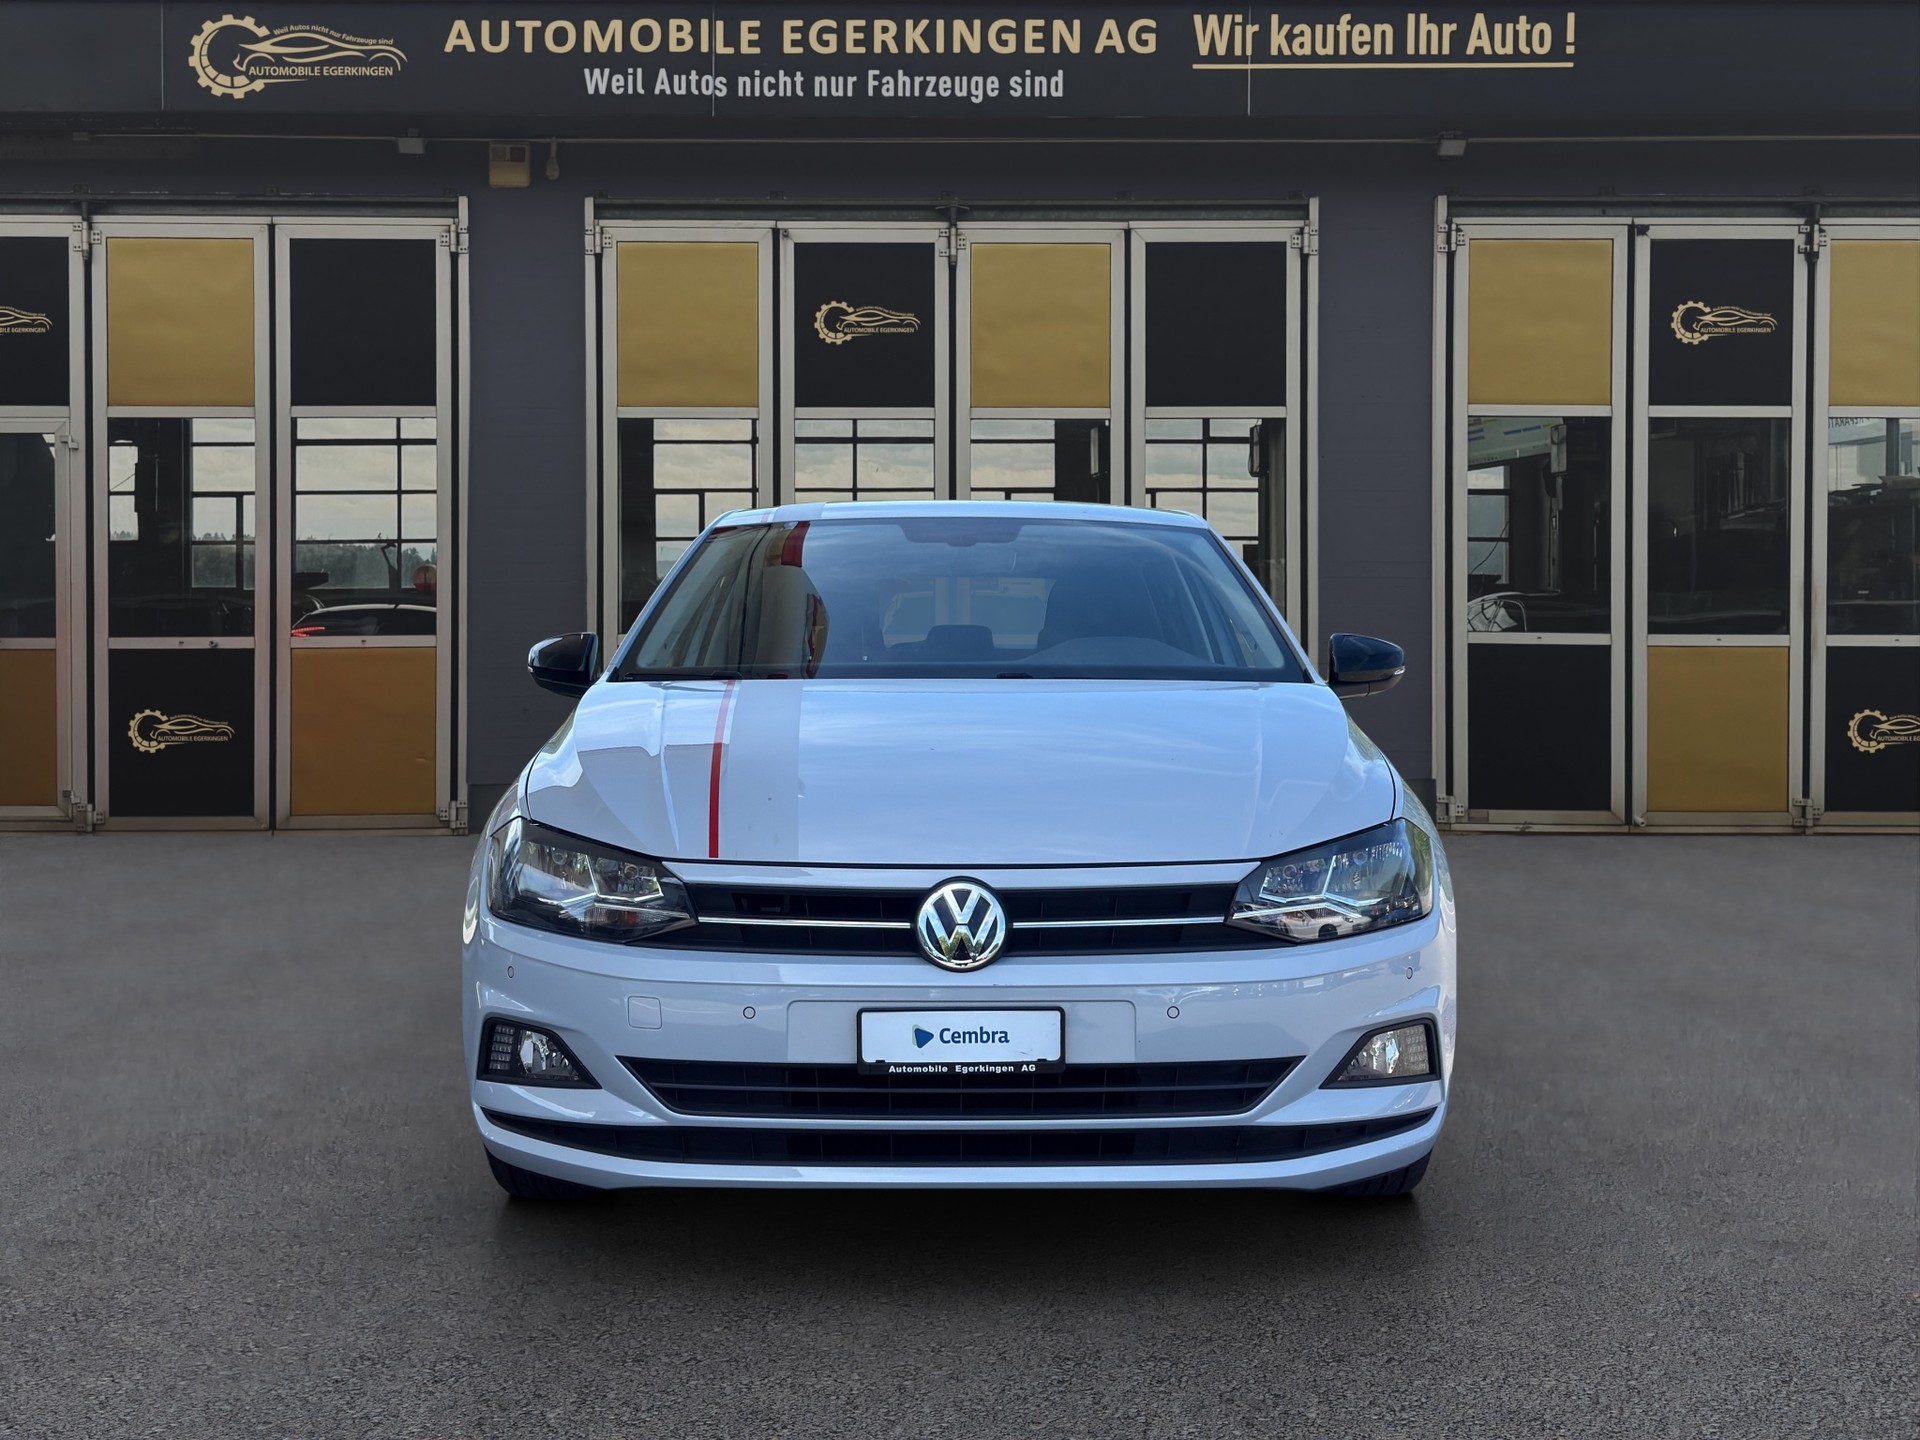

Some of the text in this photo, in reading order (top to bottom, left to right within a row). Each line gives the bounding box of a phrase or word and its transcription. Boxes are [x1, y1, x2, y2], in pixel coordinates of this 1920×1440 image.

[273, 26, 289, 36] Weil
[289, 24, 310, 32] Autos
[311, 24, 329, 34] nicht
[329, 30, 341, 38] nur
[342, 33, 377, 45] Fahrzeuge
[443, 18, 1157, 55] AUTOMOBILE EGERKINGEN AG
[1193, 11, 1576, 56] Wir kaufen Ihr Auto !
[248, 65, 394, 77] AUTOMOBILE EGERKINGEN
[583, 67, 1064, 104] Weil Autos nicht nur Fahrzeuge sind
[939, 1026, 1010, 1044] Cembra
[888, 1064, 1036, 1074] Automobile Egerkingen AG
